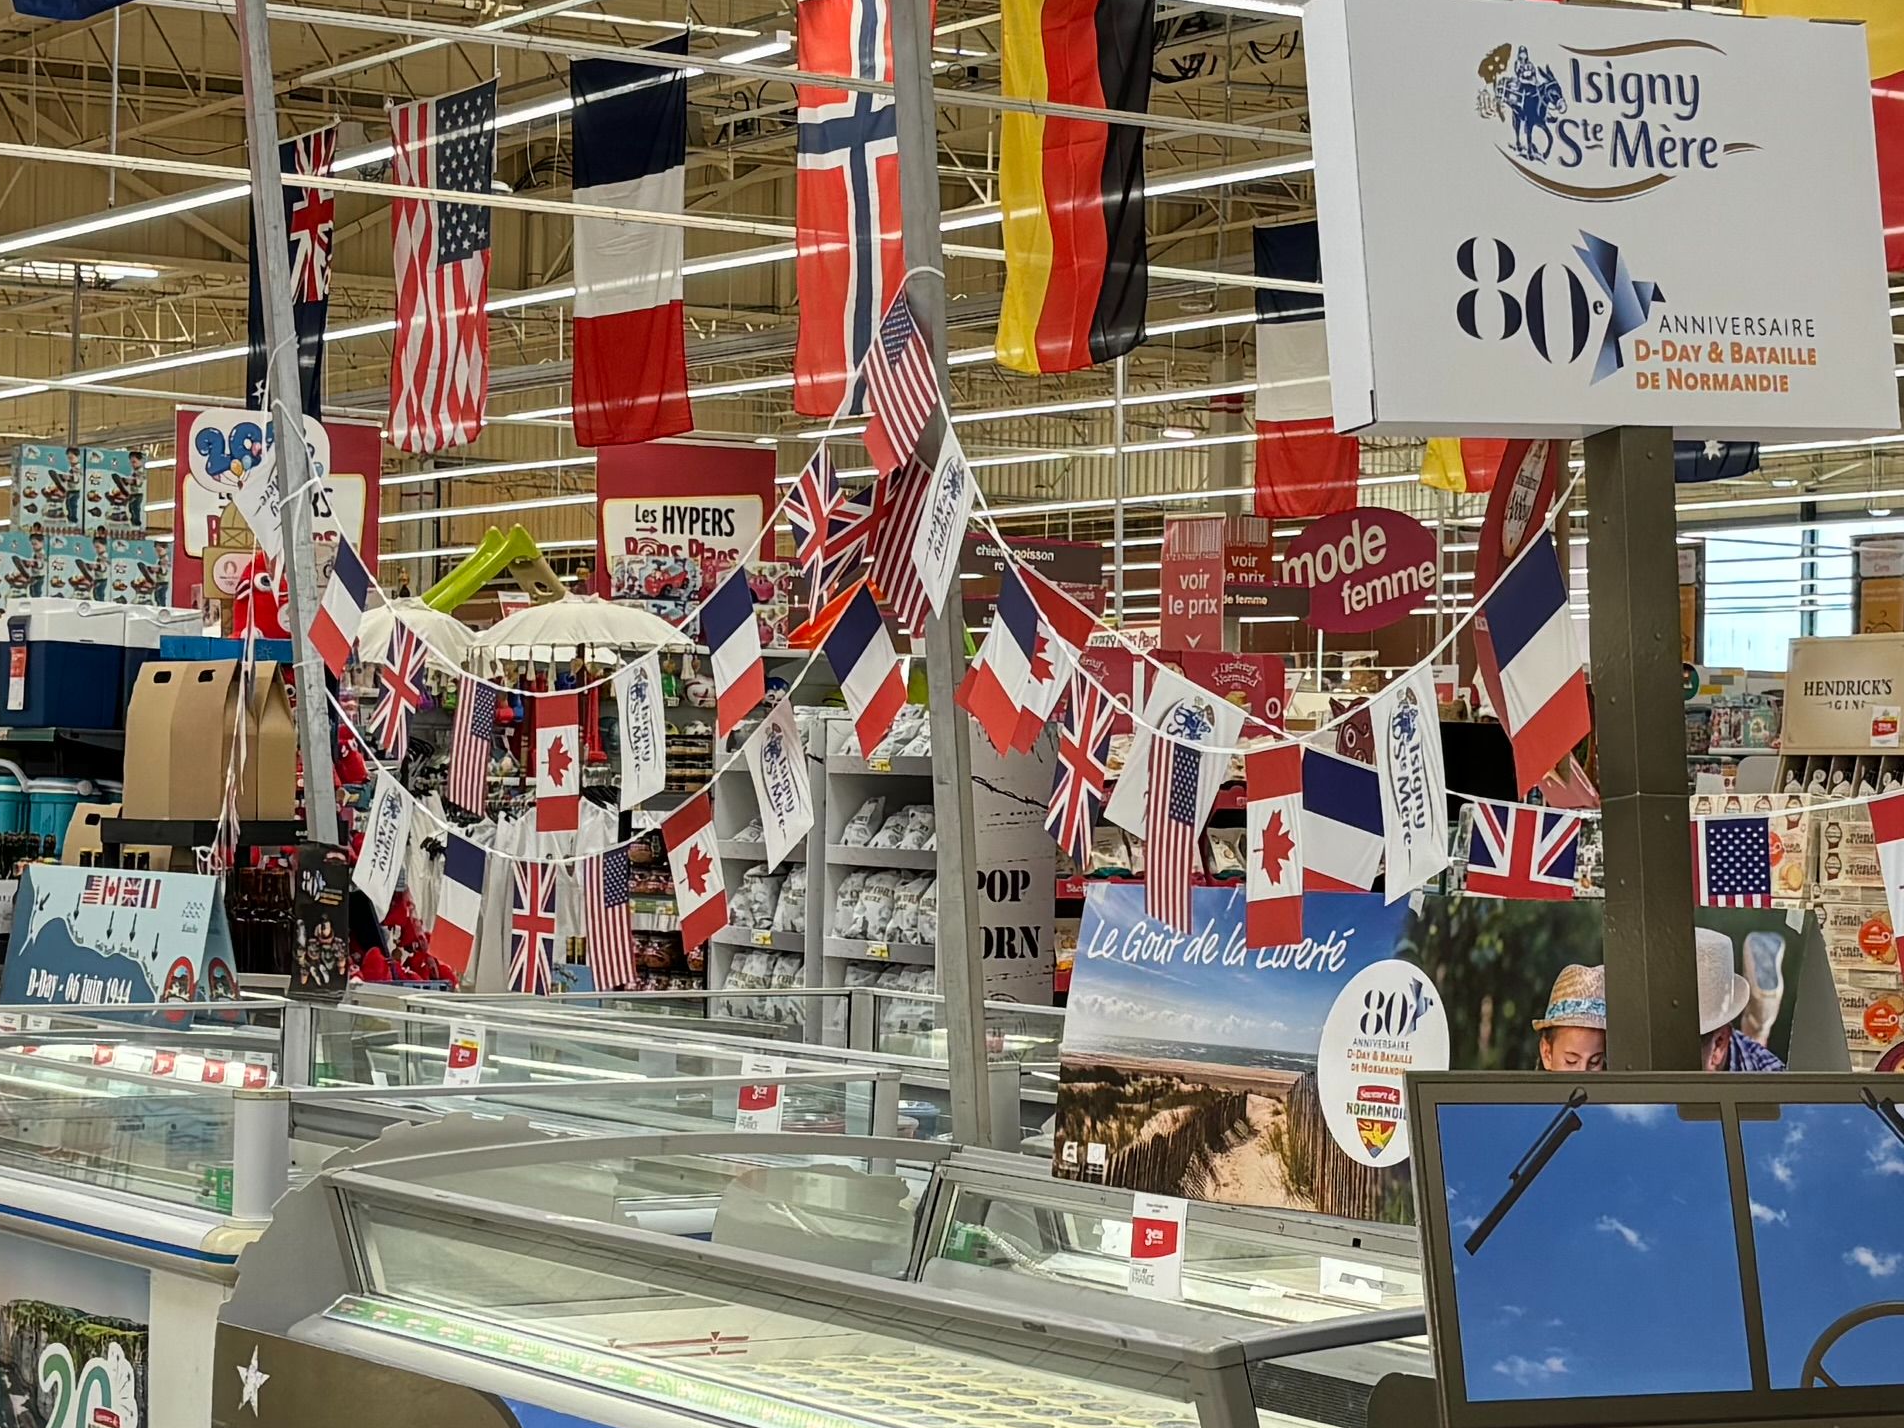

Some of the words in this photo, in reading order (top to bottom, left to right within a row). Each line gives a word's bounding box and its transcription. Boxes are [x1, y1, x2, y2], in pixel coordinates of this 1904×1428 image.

[1569, 56, 1701, 121] Isigny
[1610, 121, 1720, 169] Mère
[1658, 313, 1816, 338] ANNIVERSAIRE
[1707, 340, 1725, 365] &
[635, 504, 657, 524] Les
[662, 505, 736, 537] HYPERS
[1231, 554, 1258, 568] voir
[1282, 519, 1387, 588] mode
[1179, 571, 1210, 591] voir
[1341, 560, 1437, 616] femme
[1168, 595, 1184, 615] le
[1188, 593, 1219, 619] prix
[1803, 678, 1893, 698] HENDRICK'S
[1408, 745, 1426, 830] Isigny
[1396, 775, 1412, 845] Mère
[1087, 919, 1117, 959] Le
[1121, 918, 1186, 967] Goût
[1186, 917, 1218, 965] de
[1221, 922, 1247, 967] la
[26, 968, 57, 1001] D-Day
[64, 972, 81, 1001] 06
[81, 974, 104, 1004] juin
[1352, 1037, 1410, 1051] ANNIVERSAIRE
